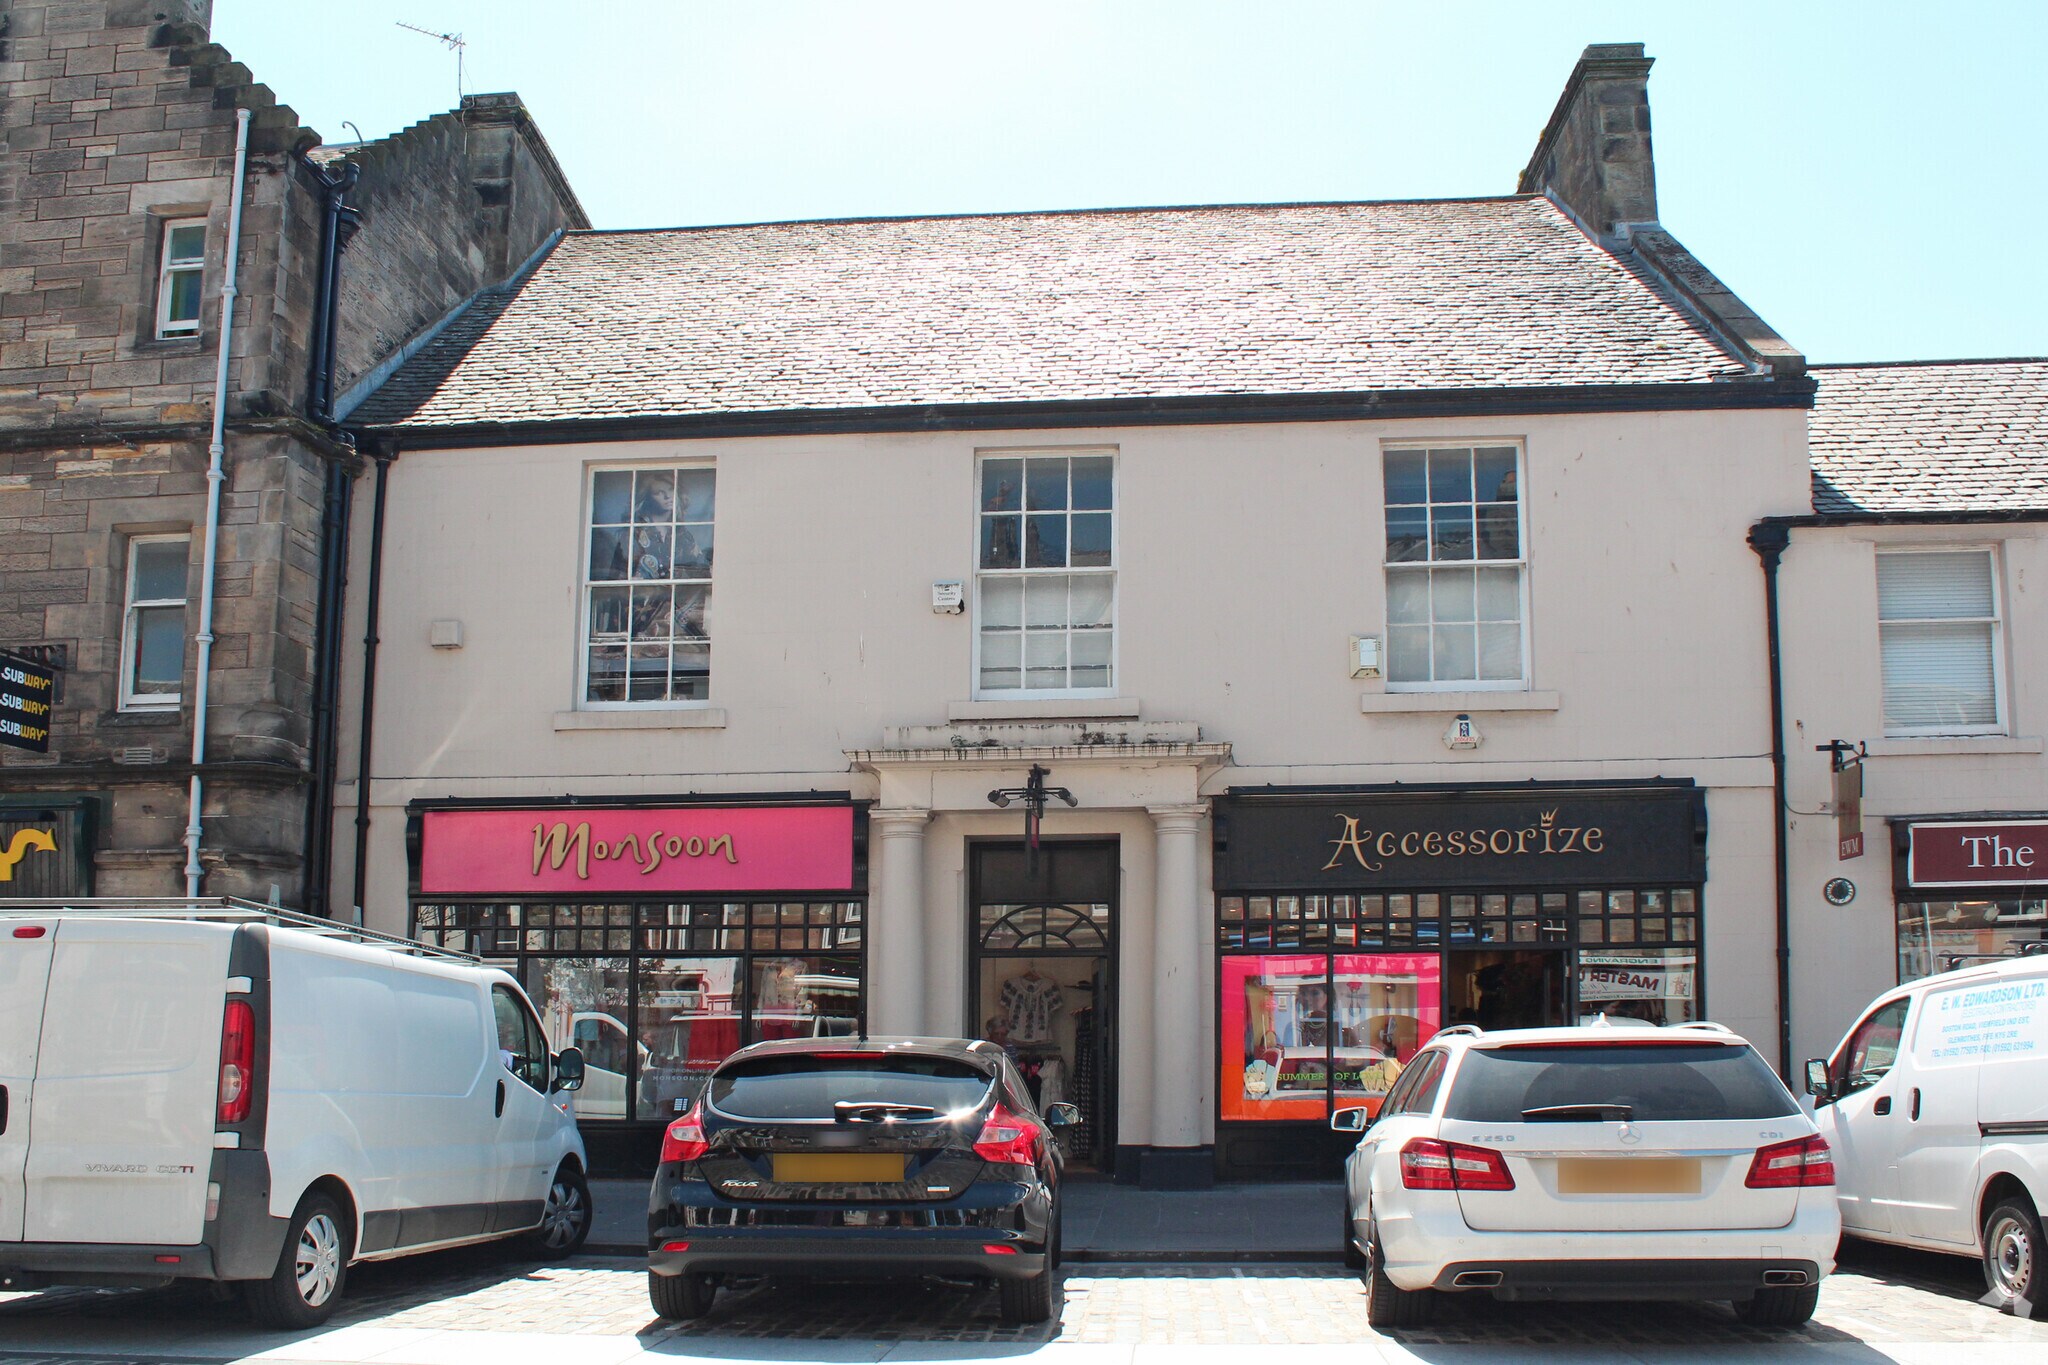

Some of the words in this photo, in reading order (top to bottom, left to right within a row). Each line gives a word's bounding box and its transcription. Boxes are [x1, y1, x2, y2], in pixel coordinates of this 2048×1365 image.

[1, 666, 51, 690] SUBWAY
[0, 692, 49, 715] SUBWAY
[0, 719, 48, 741] SUBWAY
[531, 821, 739, 880] Monsoon
[1321, 808, 1604, 872] Accessorize
[1841, 837, 1859, 857] EWM
[1961, 835, 2036, 868] The
[1963, 986, 2022, 1008] EDWARDSON
[2024, 982, 2046, 999] LTD.
[1276, 1072, 1325, 1082] SUMMER
[1333, 1072, 1350, 1081] OF
[85, 1163, 149, 1174] VIVARO
[721, 1179, 759, 1187] FOCUS
